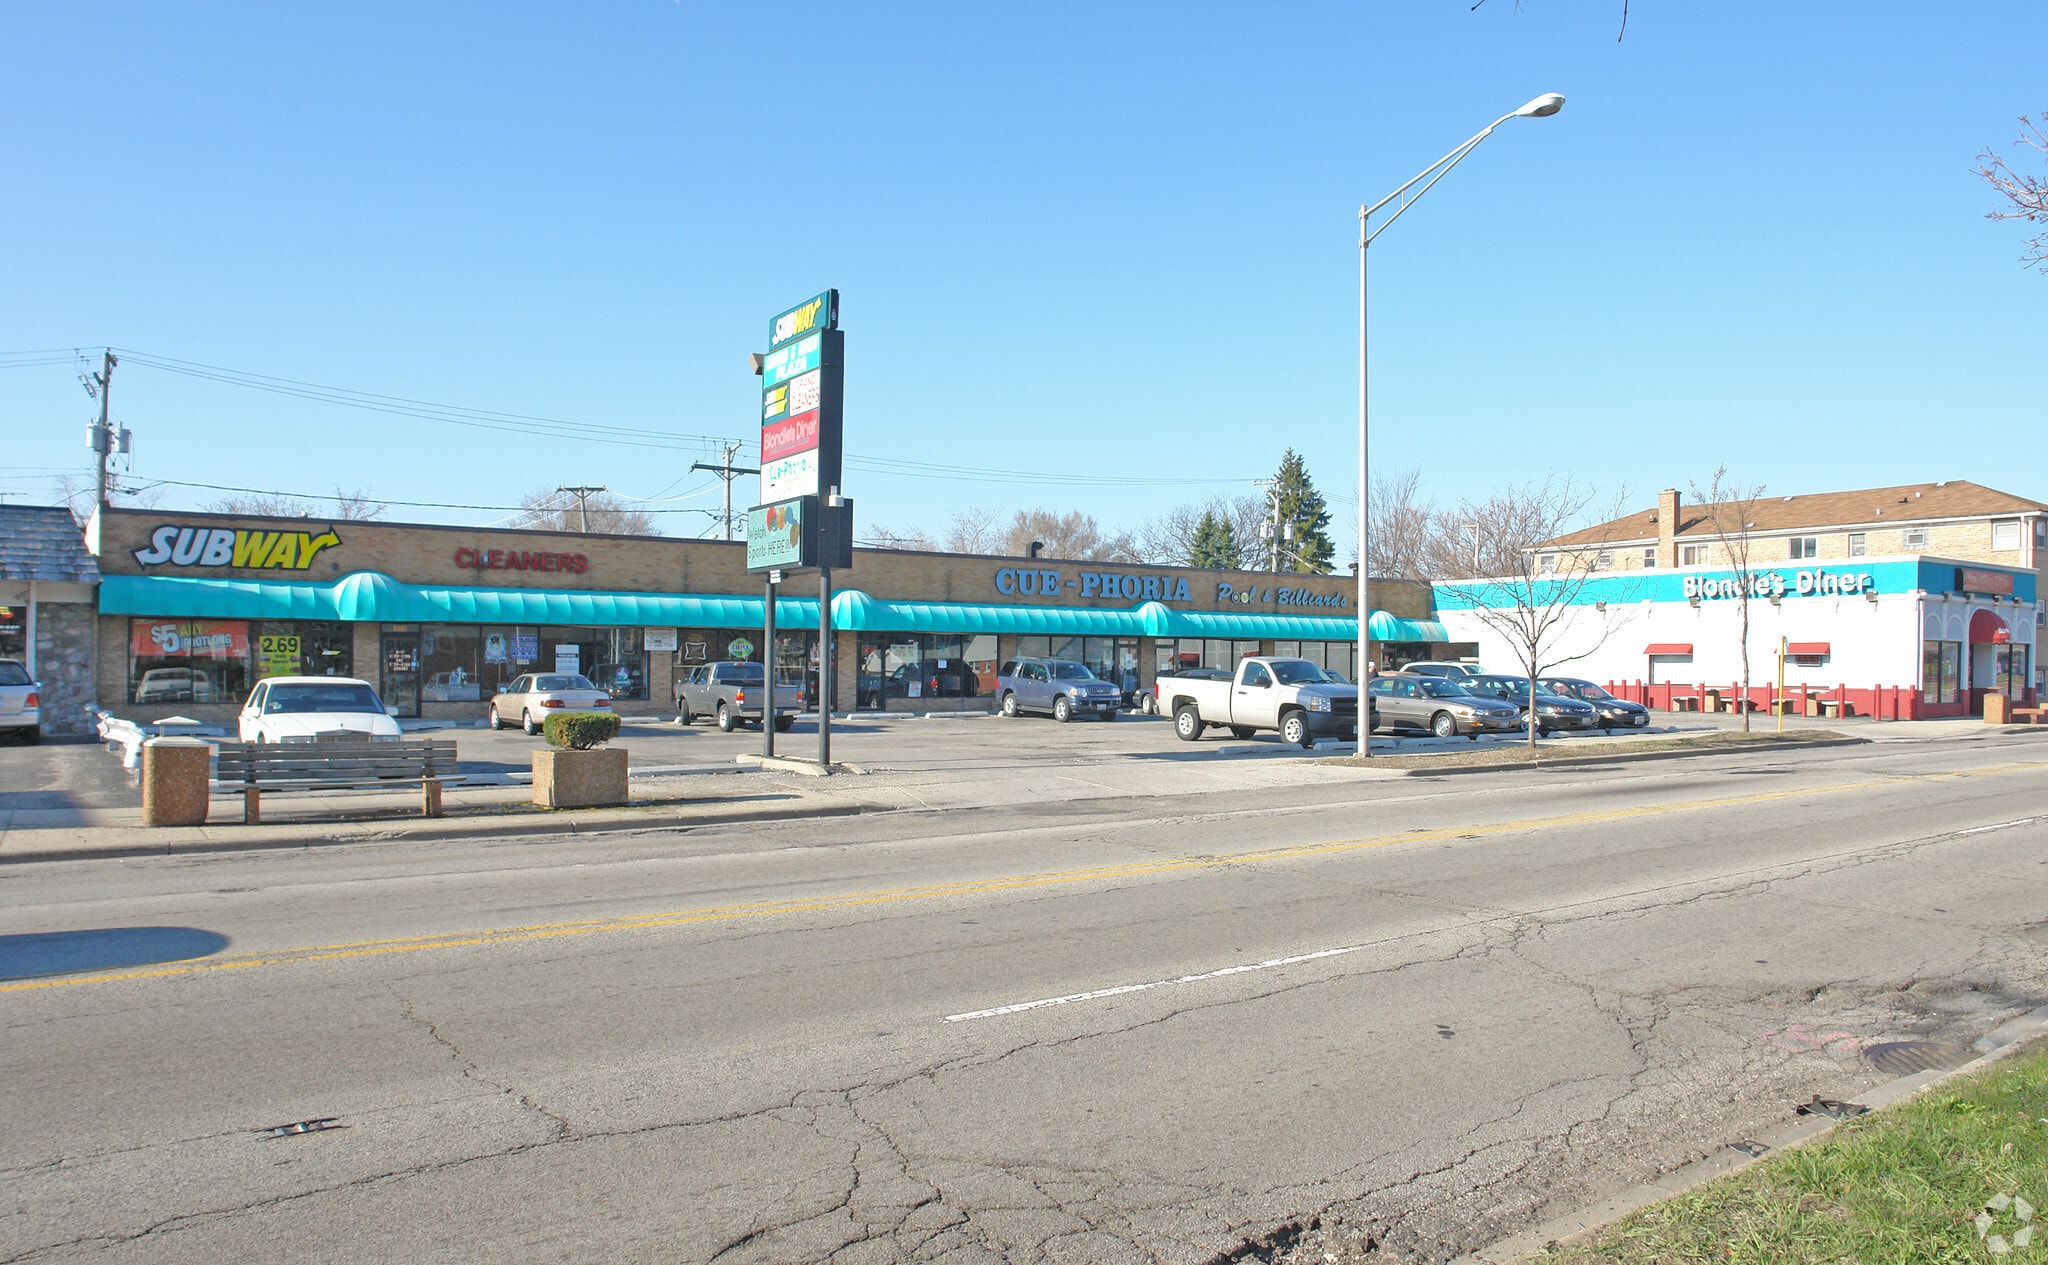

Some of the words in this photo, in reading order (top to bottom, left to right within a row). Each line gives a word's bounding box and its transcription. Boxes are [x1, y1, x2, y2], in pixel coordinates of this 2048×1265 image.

[772, 297, 822, 345] SUBWAY
[776, 355, 807, 381] PLAZA
[796, 418, 817, 440] Diner
[133, 524, 342, 571] SUBWAY
[454, 547, 589, 574] CLEANERS
[1796, 567, 1870, 595] Diner
[1263, 588, 1271, 603] &
[1277, 586, 1348, 609] Billiards
[151, 623, 181, 653] $5
